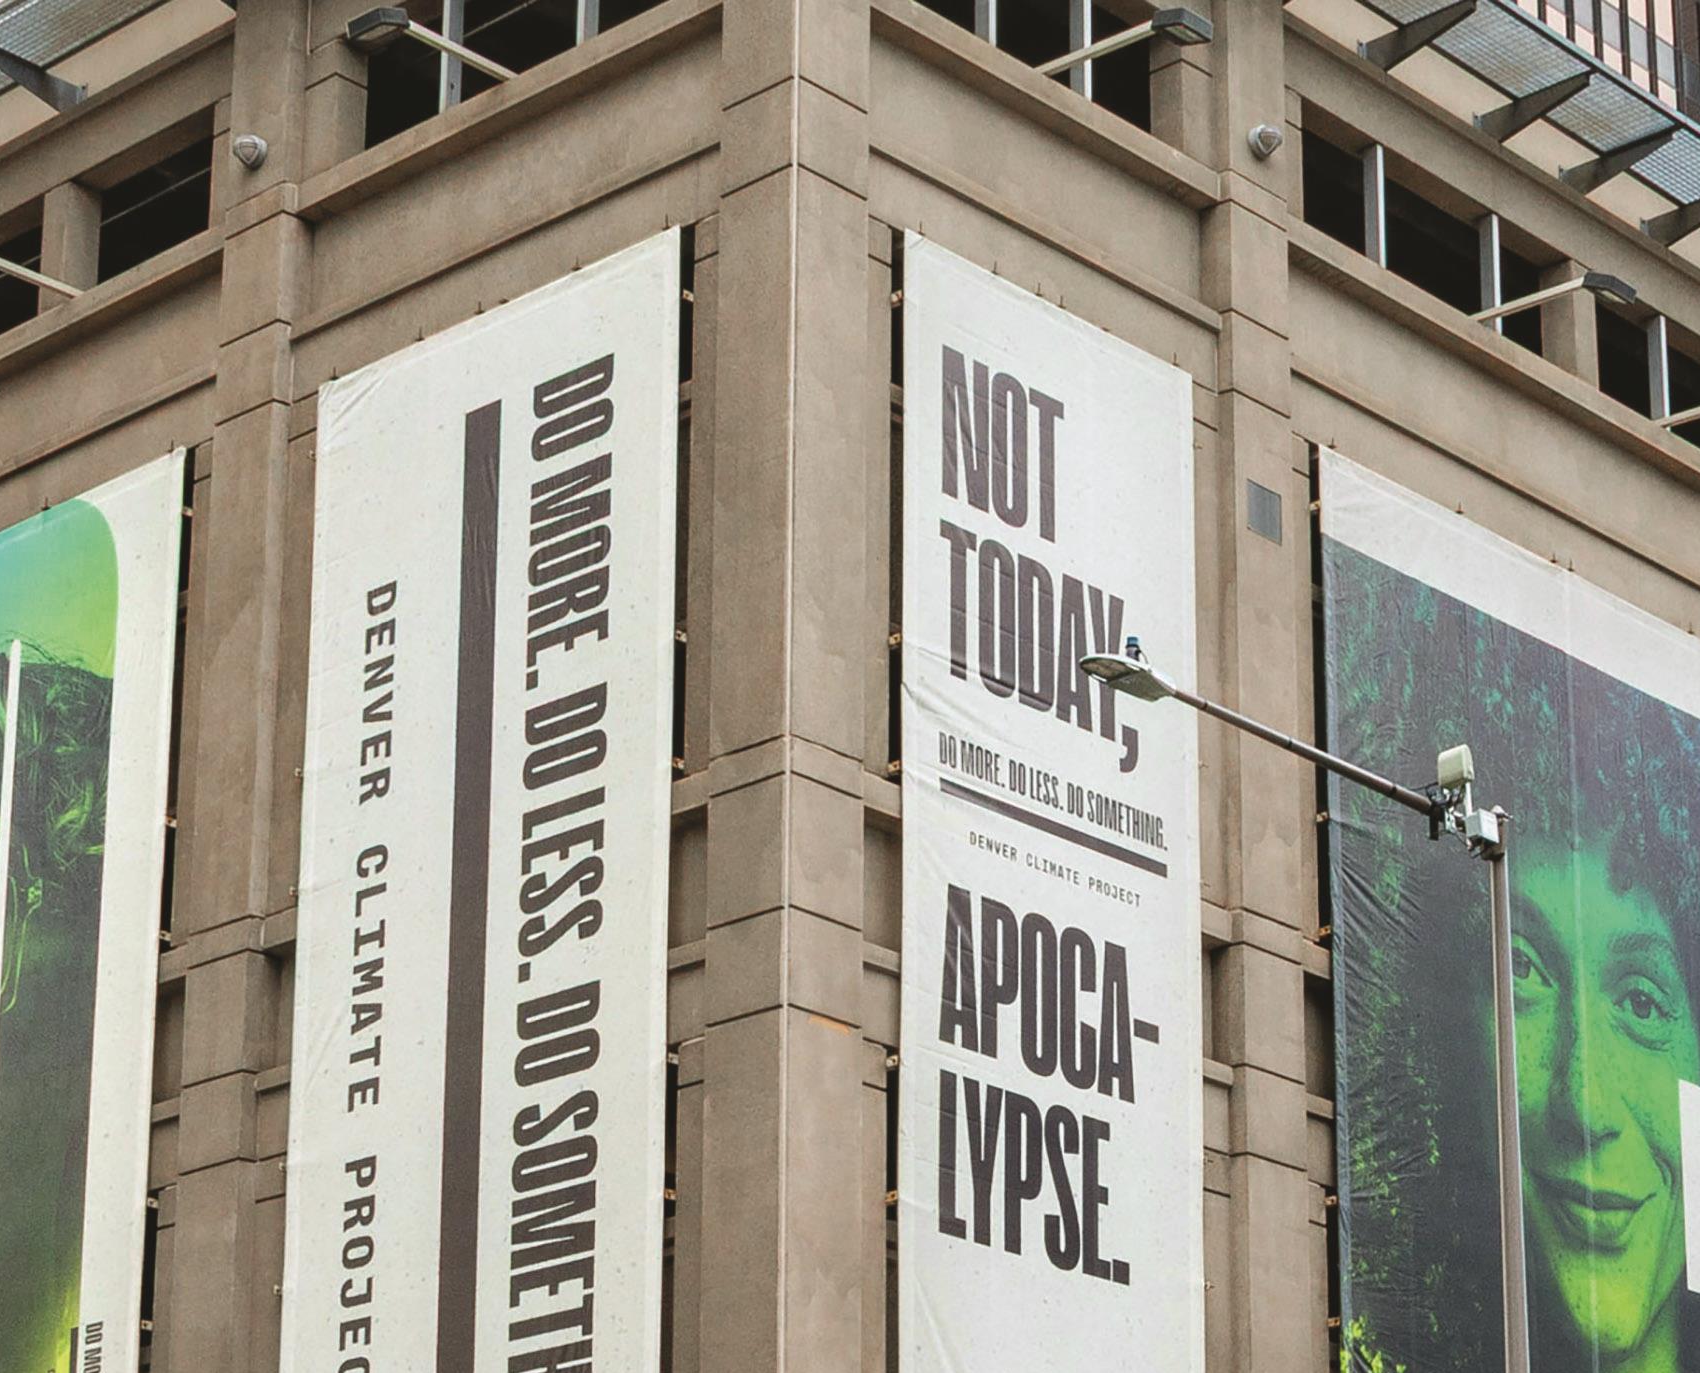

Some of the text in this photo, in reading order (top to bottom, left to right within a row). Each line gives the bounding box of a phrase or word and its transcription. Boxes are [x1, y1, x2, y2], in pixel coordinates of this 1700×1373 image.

[531, 351, 615, 462] DO
[942, 344, 1064, 544] NOT
[525, 451, 613, 691] MORE.
[940, 518, 1139, 773] TODAY,
[359, 579, 397, 806] DENVER
[523, 680, 607, 791] DO
[939, 732, 1168, 851] DO MORE. DO LESS. DO SOMETHING.
[518, 785, 605, 983] LESS.
[970, 831, 1141, 908] DENVER CLIMATE PROJECT
[346, 843, 389, 1114] CLIMATE
[514, 979, 601, 1088] DO
[938, 883, 1160, 1104] APOCA-
[938, 1069, 1131, 1286] LYPSE.
[85, 1320, 104, 1348] DO
